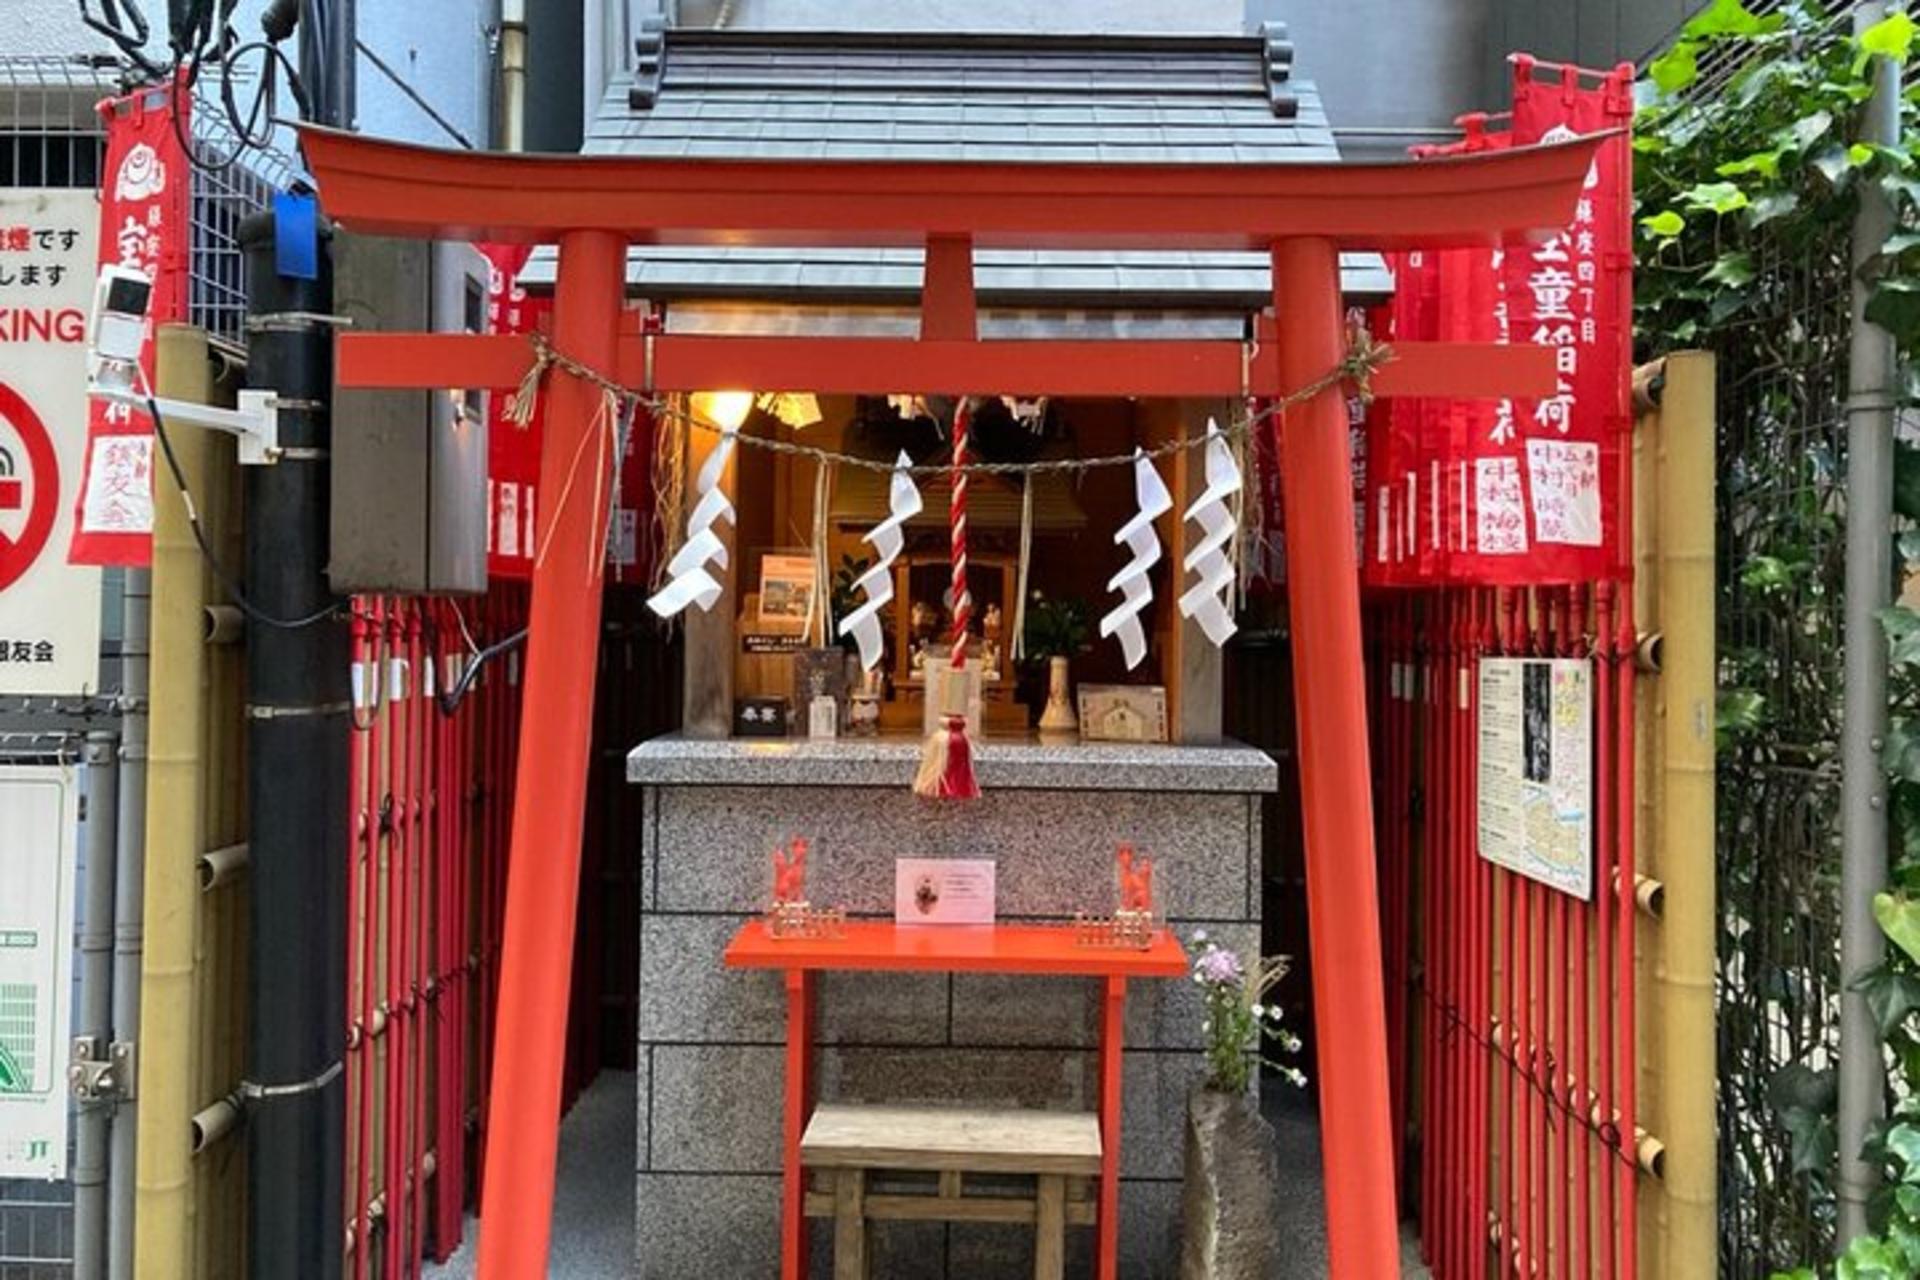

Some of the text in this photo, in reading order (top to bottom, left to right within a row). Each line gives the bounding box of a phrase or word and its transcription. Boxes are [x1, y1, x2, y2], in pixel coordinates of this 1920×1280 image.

[0, 227, 79, 252] 煙です
[26, 1141, 51, 1161] JT
